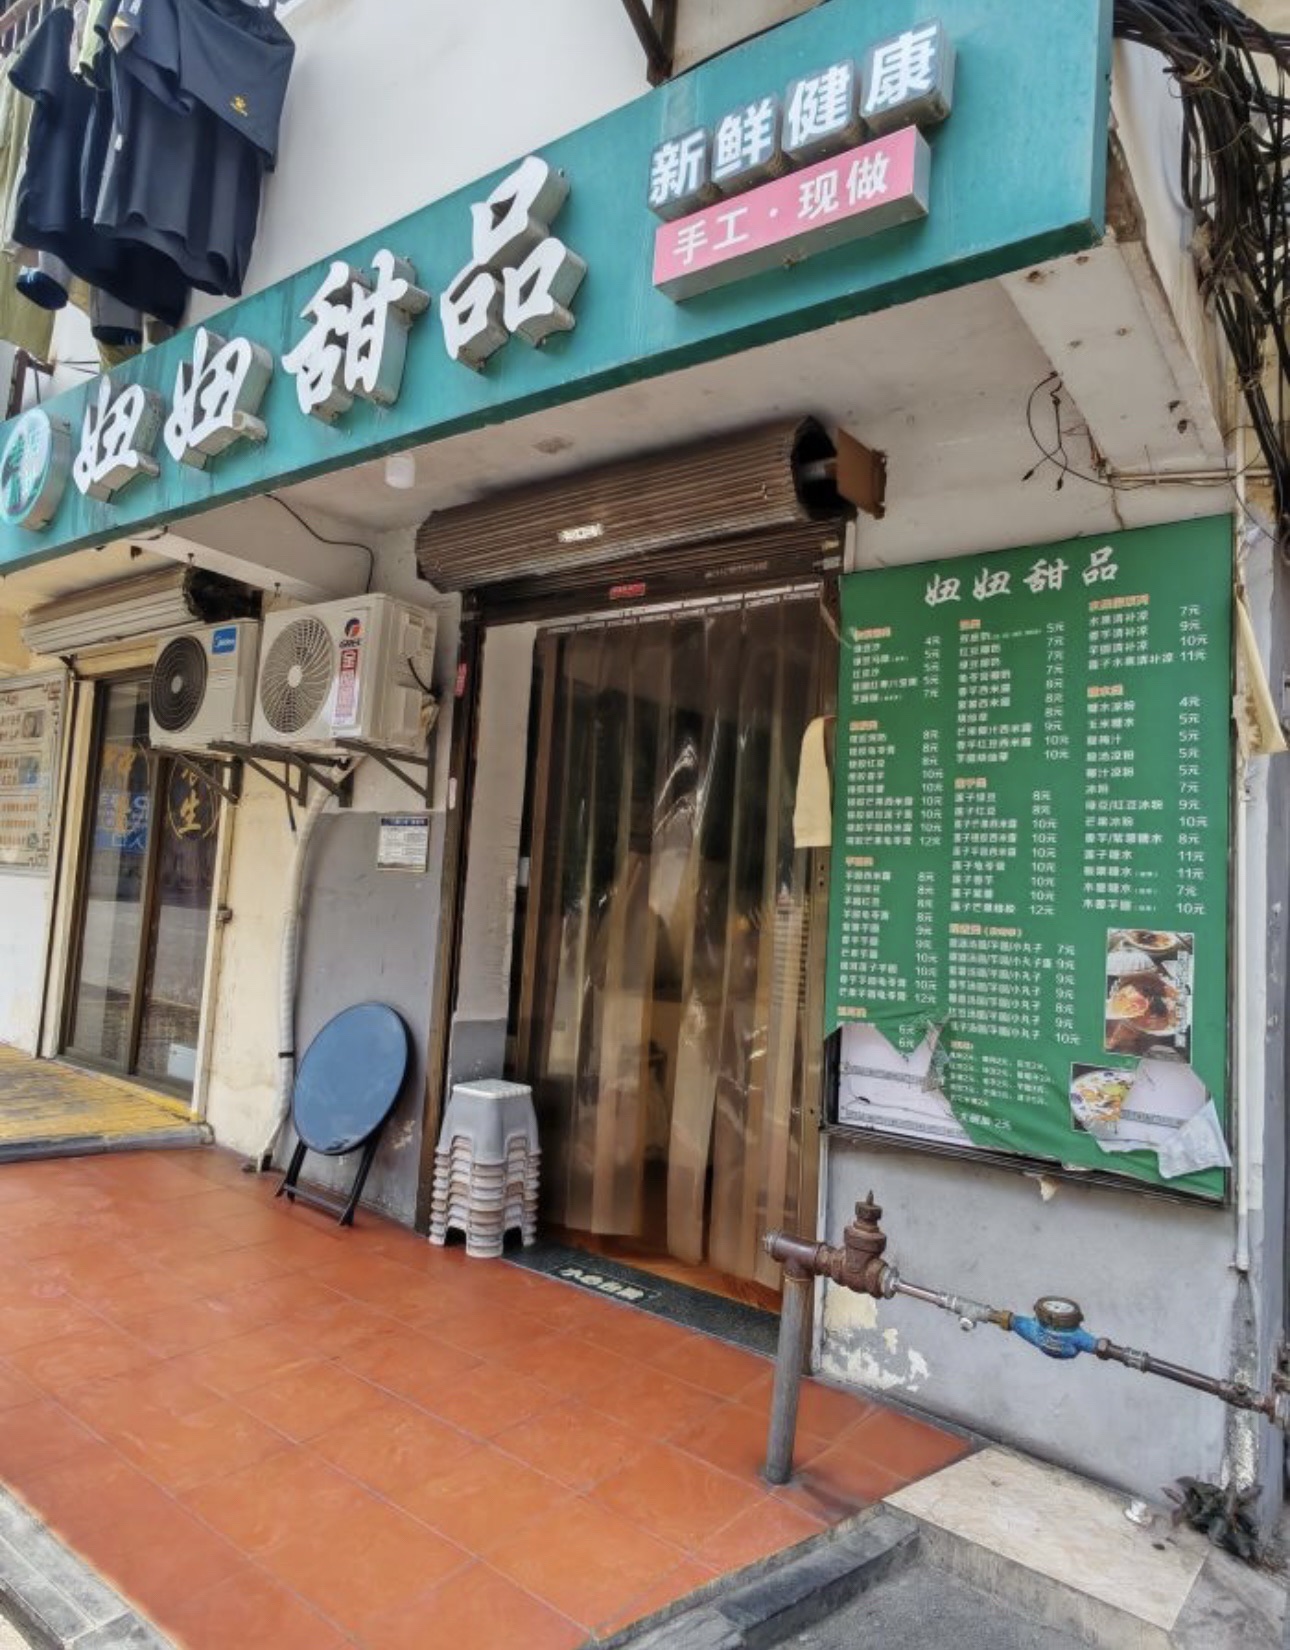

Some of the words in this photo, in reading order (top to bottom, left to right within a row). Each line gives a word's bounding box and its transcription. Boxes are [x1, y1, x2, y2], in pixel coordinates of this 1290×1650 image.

[649, 24, 938, 206] 新鲜健康
[73, 155, 580, 497] 妞妞甜品
[925, 546, 1118, 606] 妞妞甜品
[1179, 604, 1200, 616] 7元
[1179, 619, 1200, 631] 9元
[1180, 634, 1208, 646] 10元
[1180, 650, 1207, 662] 11元
[1179, 696, 1200, 707] 4元
[1179, 713, 1200, 725] 5元
[1179, 730, 1200, 742] 5元
[1179, 748, 1200, 759] 5元
[1179, 765, 1200, 776] 5元
[1180, 782, 1200, 793] 7元
[1179, 799, 1200, 810] 9元
[1179, 816, 1208, 827] 10元
[1179, 832, 1201, 844] 8元
[1178, 850, 1205, 861] 11元
[1177, 867, 1206, 879] 11元
[1177, 884, 1198, 896] 7元
[1177, 902, 1207, 915] 10元
